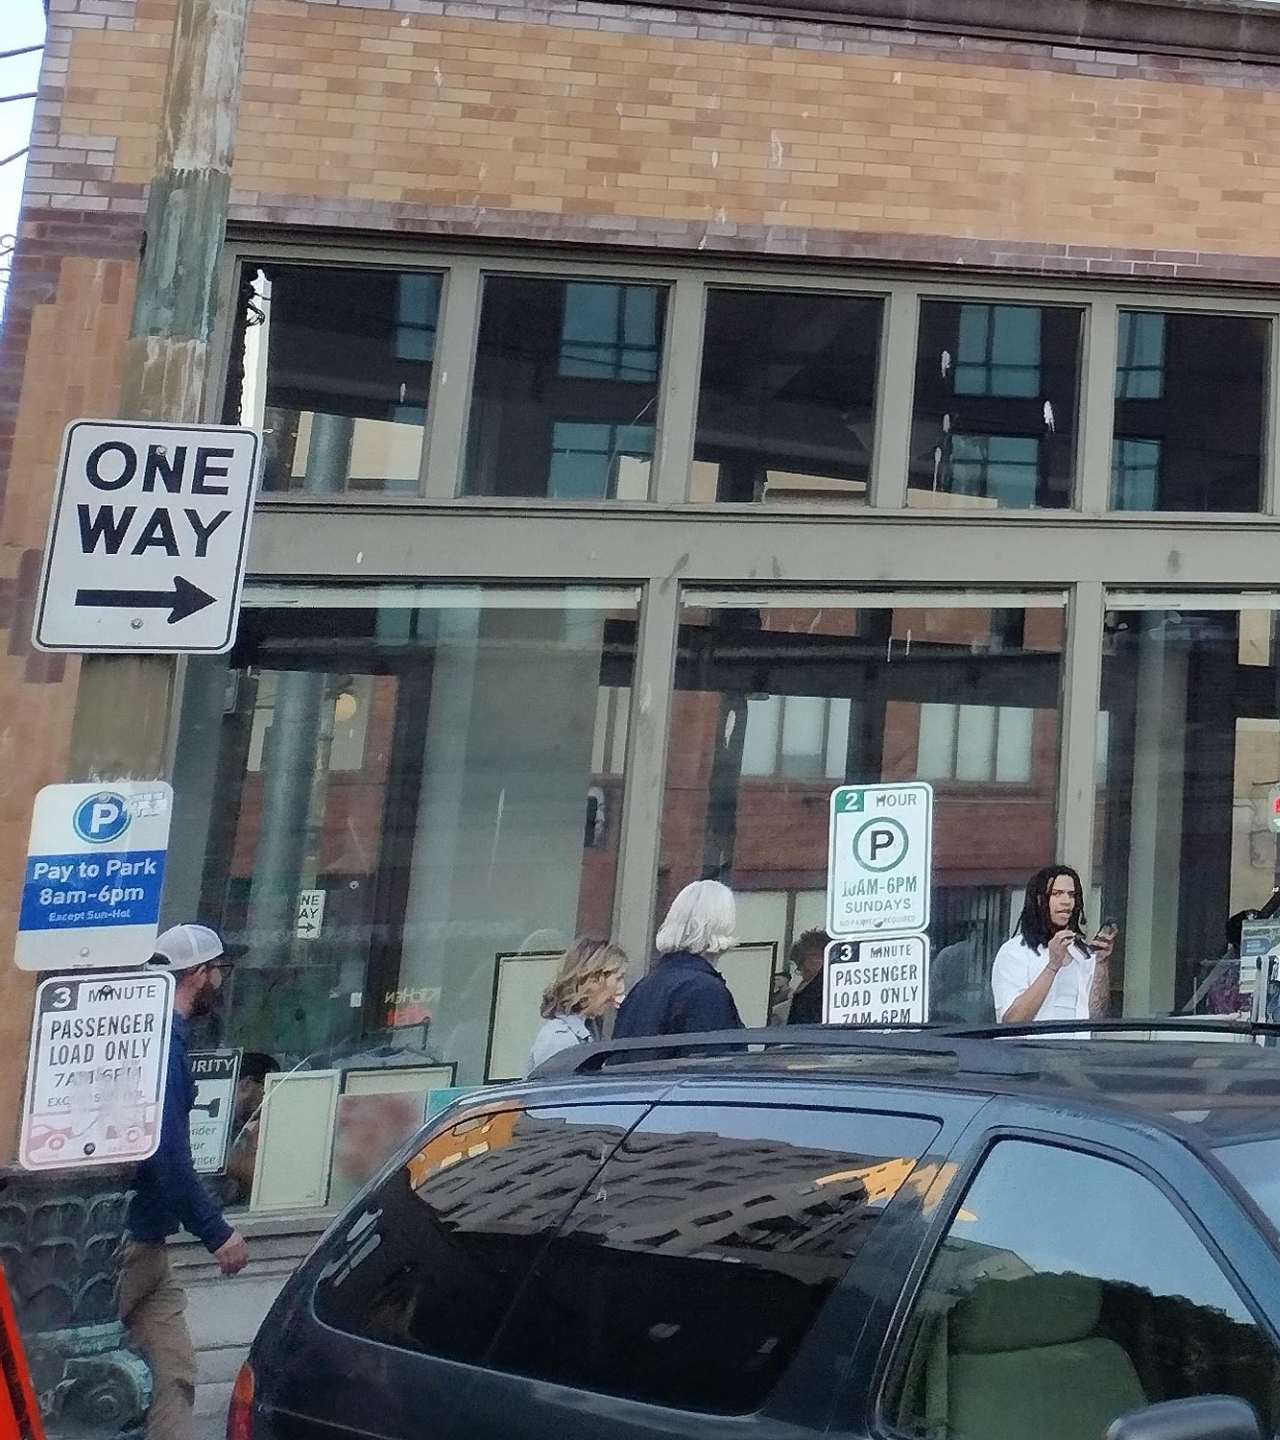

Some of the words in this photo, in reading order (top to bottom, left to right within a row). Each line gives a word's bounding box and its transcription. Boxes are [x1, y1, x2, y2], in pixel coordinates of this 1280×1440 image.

[86, 441, 235, 496] ONE
[77, 504, 232, 558] WAY
[845, 793, 858, 810] 2
[876, 793, 917, 807] HOUR
[90, 803, 119, 834] P
[870, 830, 894, 861] P
[33, 862, 75, 883] Pay
[79, 861, 99, 879] to
[106, 857, 157, 877] Park
[39, 885, 145, 906] 8am-6pm
[301, 895, 320, 905] NE
[845, 898, 911, 914] SUNDAYS
[48, 911, 84, 923] Except
[298, 908, 318, 919] AY
[840, 945, 852, 960] 3
[870, 944, 912, 959] MINUTE
[836, 964, 918, 986] PASSENGER
[52, 986, 72, 1008] 3
[834, 989, 871, 1008] LOAD
[881, 986, 918, 1004] ONLY
[50, 1014, 154, 1041] PASSENGER
[49, 1043, 94, 1066] LOAD
[105, 1038, 152, 1061] ONLY
[192, 1058, 234, 1072] RITY
